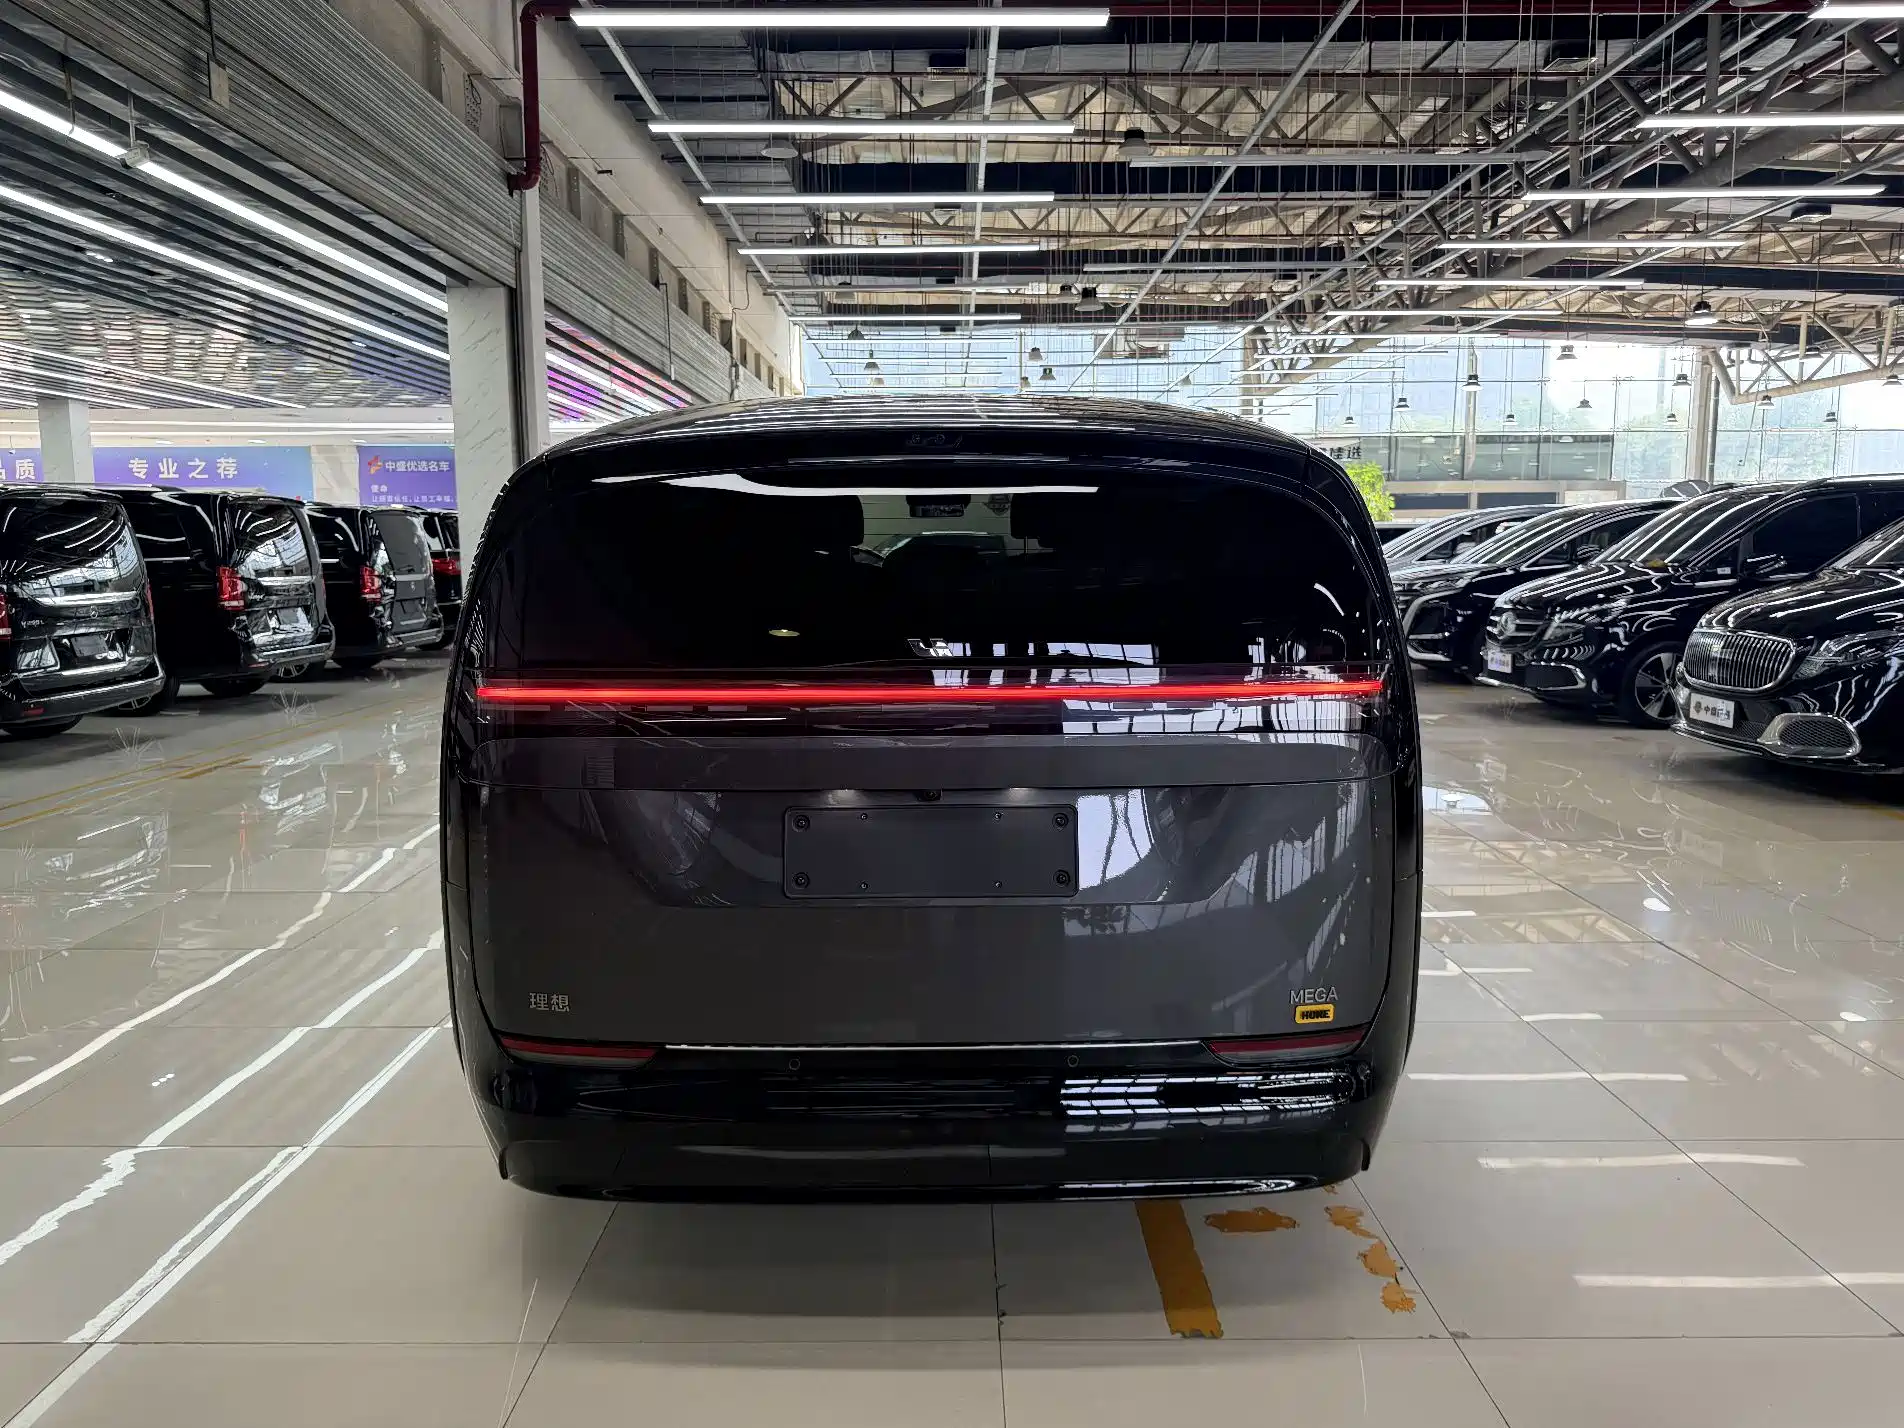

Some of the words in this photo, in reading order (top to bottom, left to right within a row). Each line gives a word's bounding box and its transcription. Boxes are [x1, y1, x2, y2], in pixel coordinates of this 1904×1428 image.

[0, 458, 36, 480] 质
[128, 457, 238, 479] 专业之荐
[529, 992, 570, 1012] 理想
[1290, 986, 1339, 1004] MEGA
